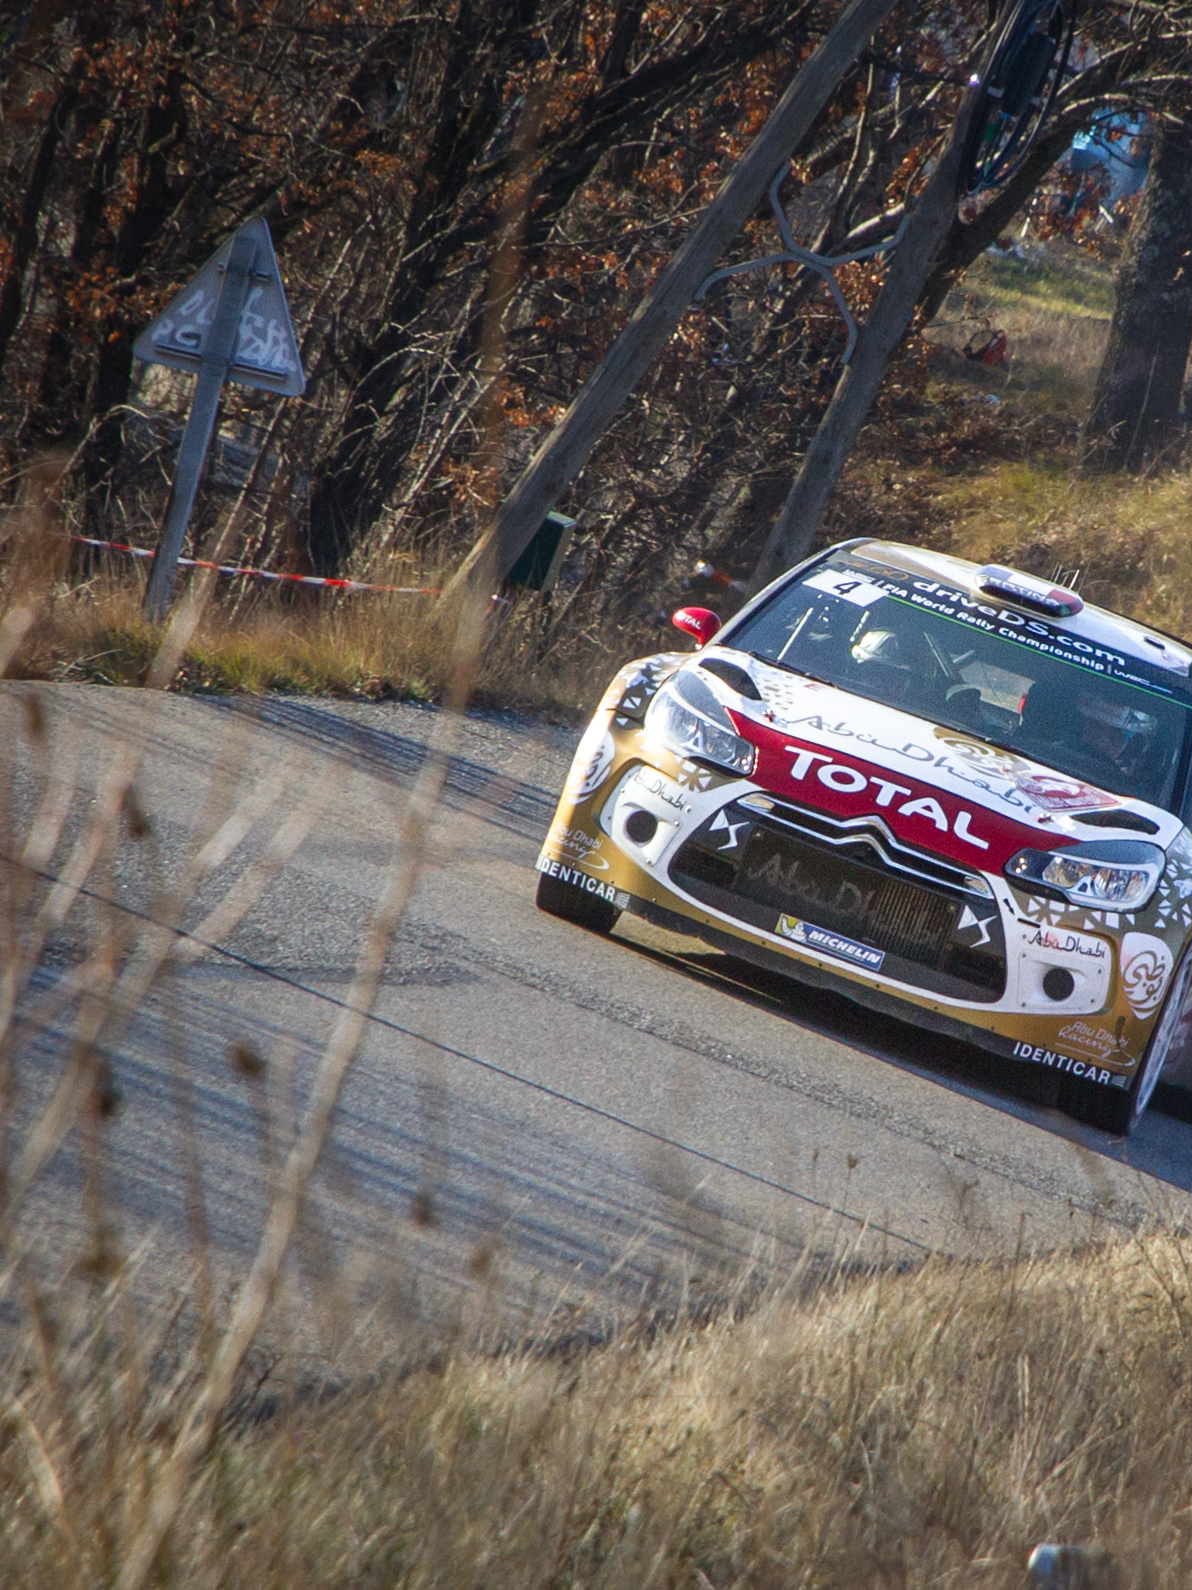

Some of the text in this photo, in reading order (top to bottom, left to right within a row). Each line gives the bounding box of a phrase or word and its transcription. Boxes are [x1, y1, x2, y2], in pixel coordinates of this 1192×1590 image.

[833, 580, 862, 596] 4
[675, 611, 702, 631] TAL
[882, 583, 908, 598] FIA
[910, 593, 956, 615] World
[956, 610, 996, 631] Rally
[998, 626, 1105, 672] Championship
[911, 581, 1126, 667] driveDS.com
[785, 715, 897, 752] Abu
[896, 742, 1038, 814] Dhabi
[784, 745, 990, 850] TOTAL
[573, 830, 604, 850] Dhabi
[535, 854, 616, 903] IDENTICAR
[808, 930, 881, 965] MICHELIN
[1028, 930, 1107, 959] Abu Dhabi
[1072, 1021, 1094, 1040] Abu
[1013, 1041, 1111, 1085] IDENTICAR
